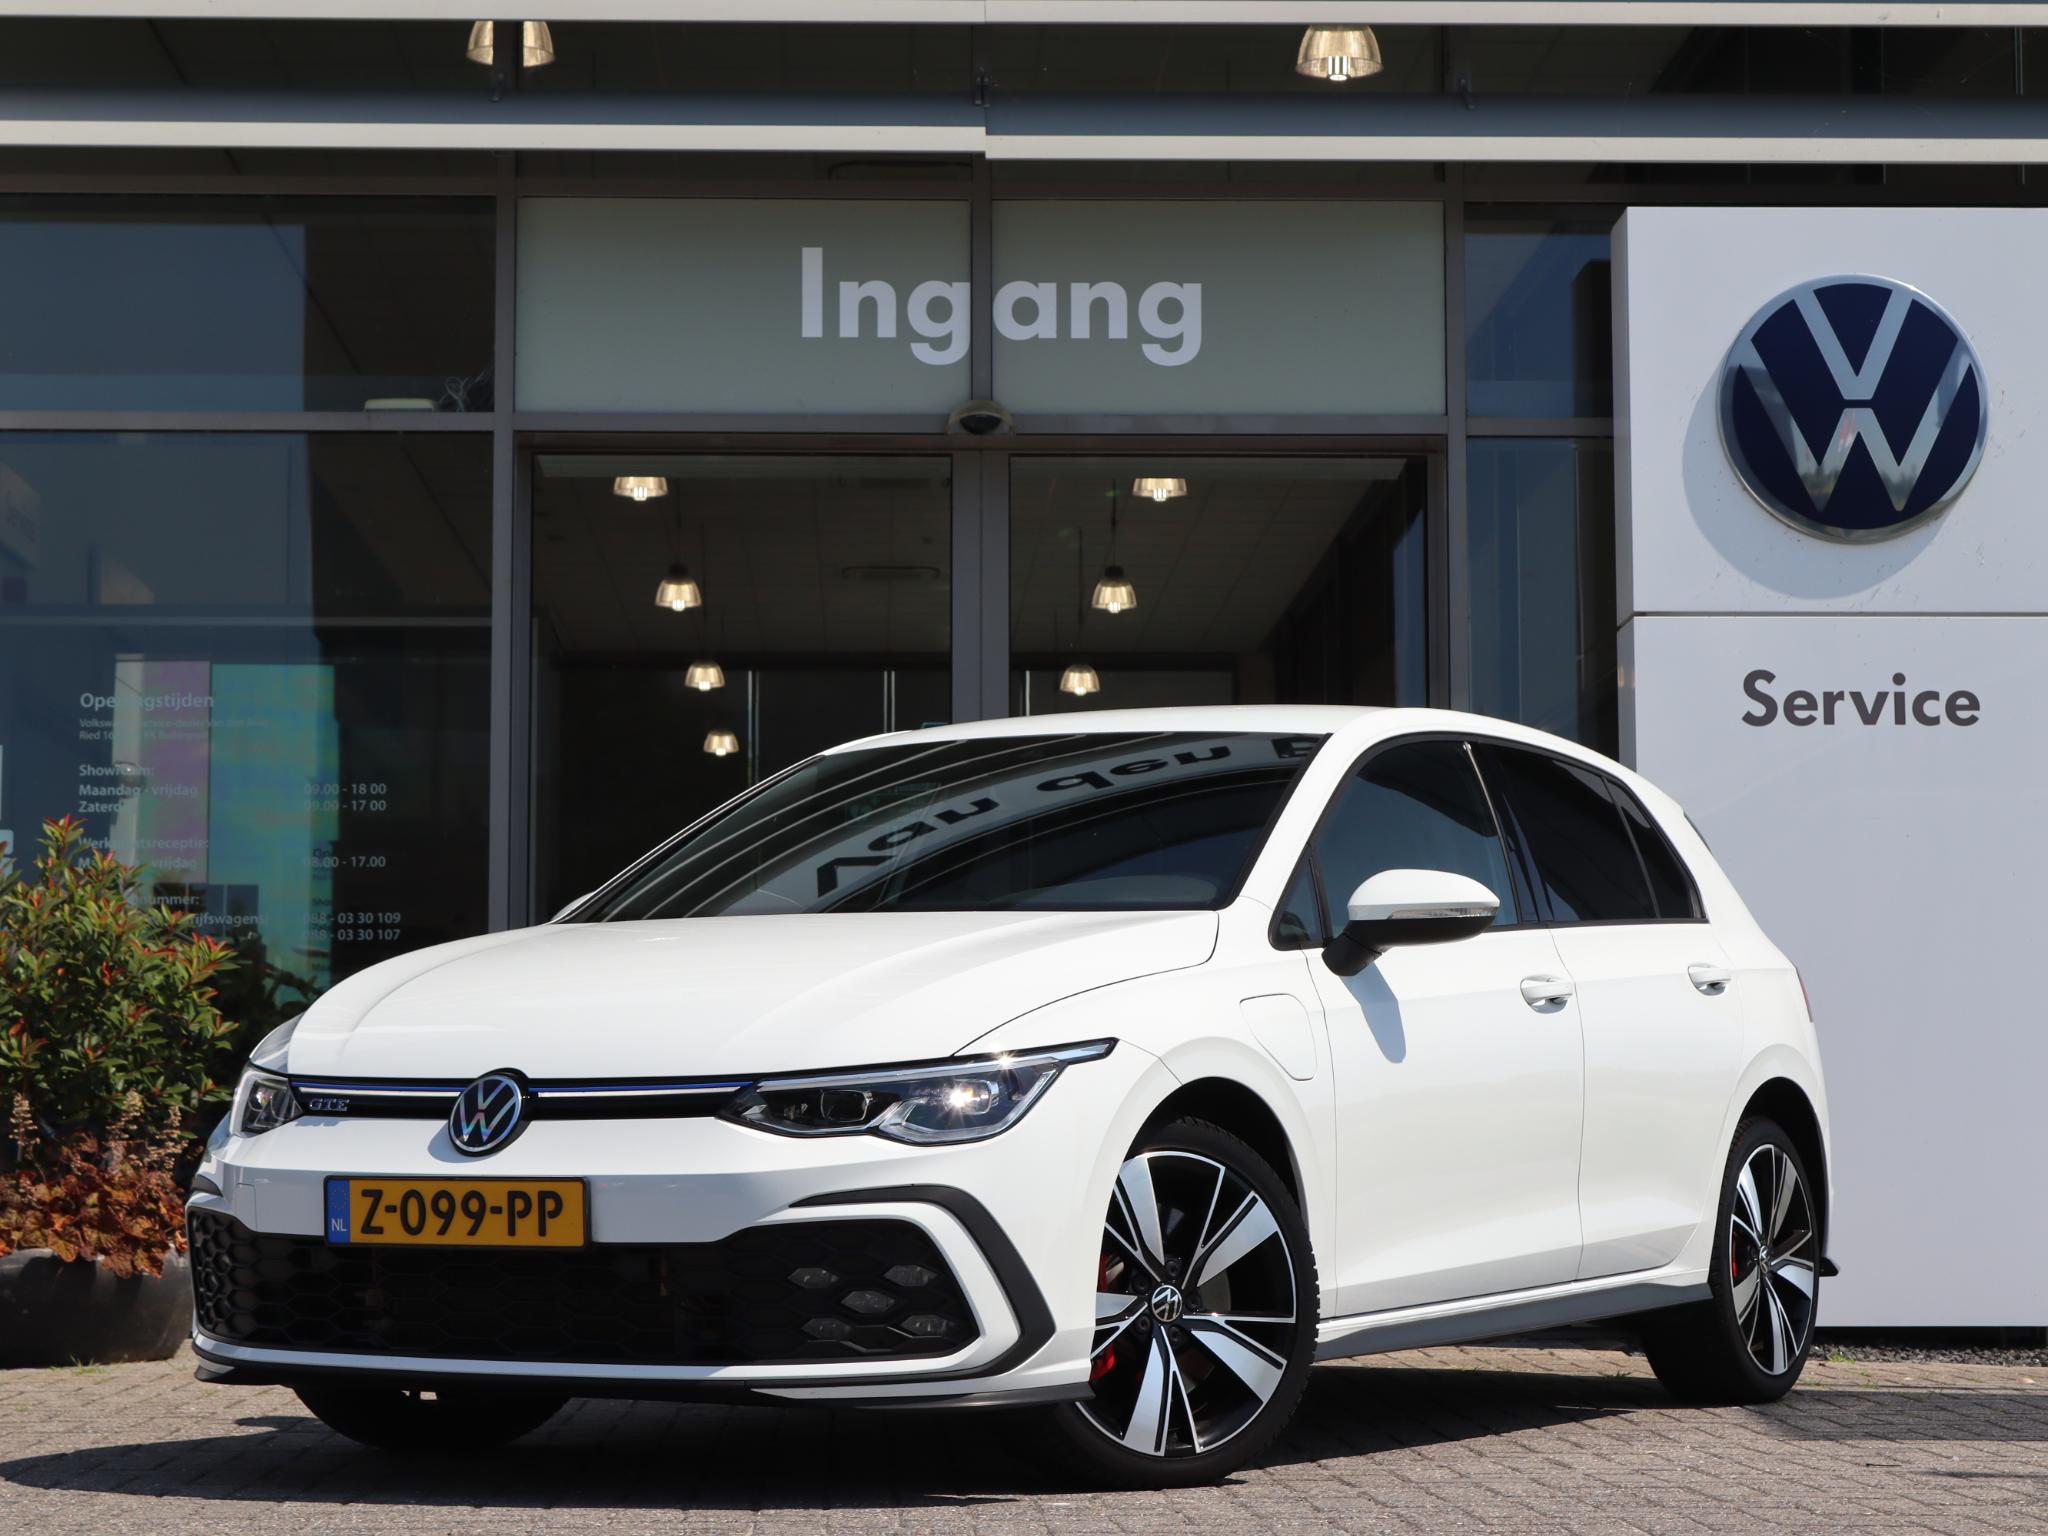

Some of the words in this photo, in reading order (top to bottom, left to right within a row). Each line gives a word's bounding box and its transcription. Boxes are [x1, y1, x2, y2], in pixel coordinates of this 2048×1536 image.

[800, 246, 1203, 367] Ingang
[80, 692, 214, 710] Opegstijden
[1741, 669, 1980, 727] Service
[79, 784, 141, 798] Maandag
[151, 784, 198, 799] vrijdag
[351, 856, 387, 868] 17.00
[337, 912, 354, 924] 03
[357, 912, 374, 924] 30
[377, 912, 401, 924] 109
[337, 929, 354, 941] 03
[357, 929, 374, 941] 30
[377, 929, 401, 941] 107
[308, 1098, 351, 1112] GTE
[331, 1218, 348, 1232] NL
[360, 1188, 564, 1237] Z-099-PP
